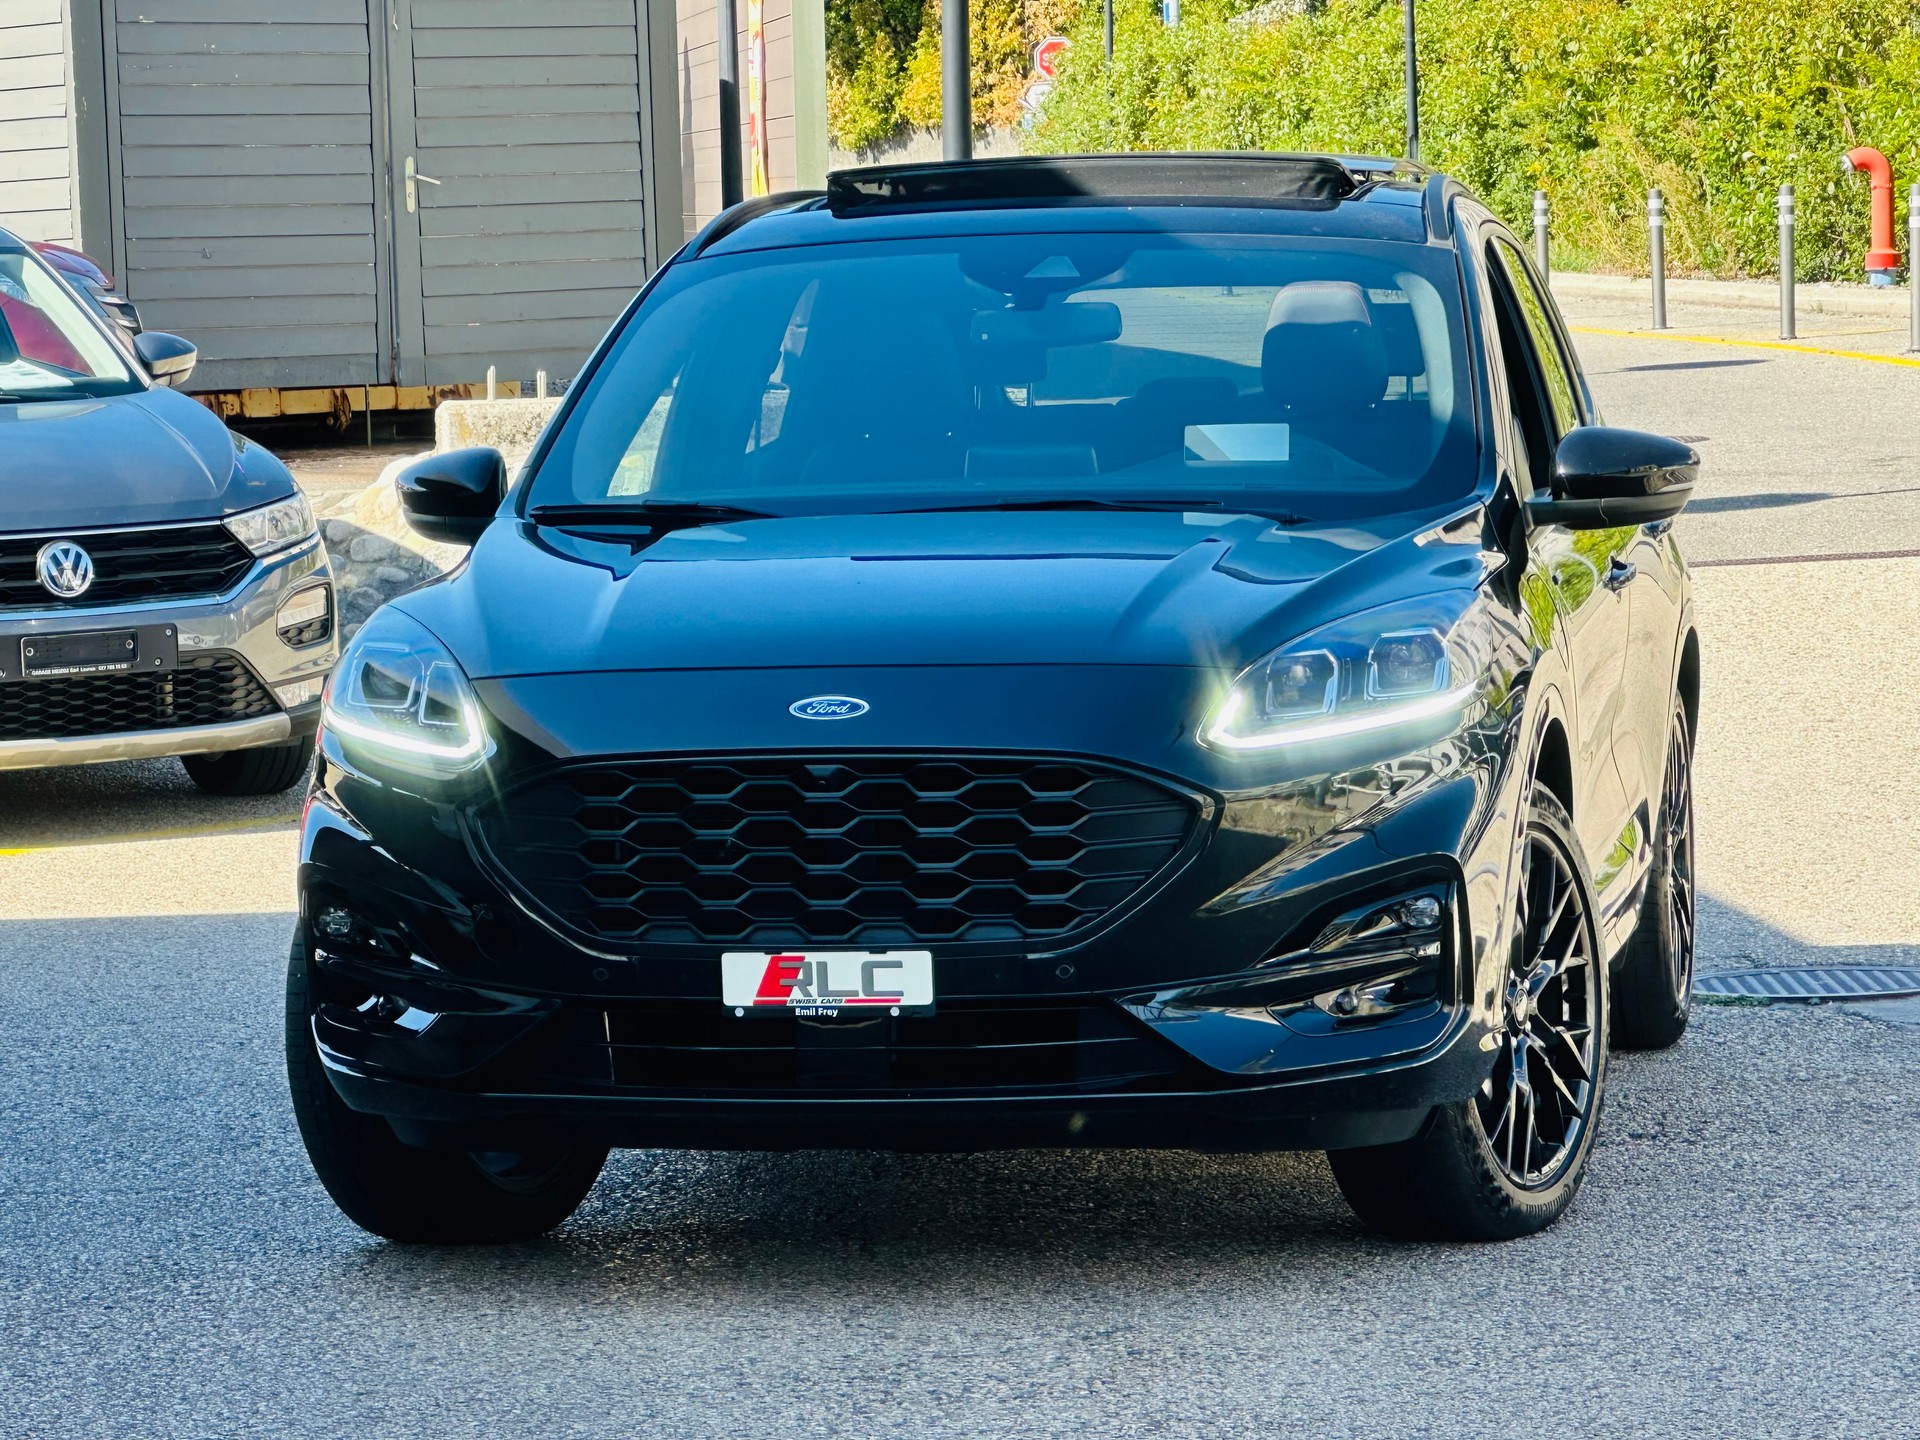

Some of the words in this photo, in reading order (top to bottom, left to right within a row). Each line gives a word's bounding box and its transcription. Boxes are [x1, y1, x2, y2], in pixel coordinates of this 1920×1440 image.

[806, 700, 851, 714] Ford
[795, 1007, 816, 1016] Emil
[818, 1007, 838, 1018] Frey
